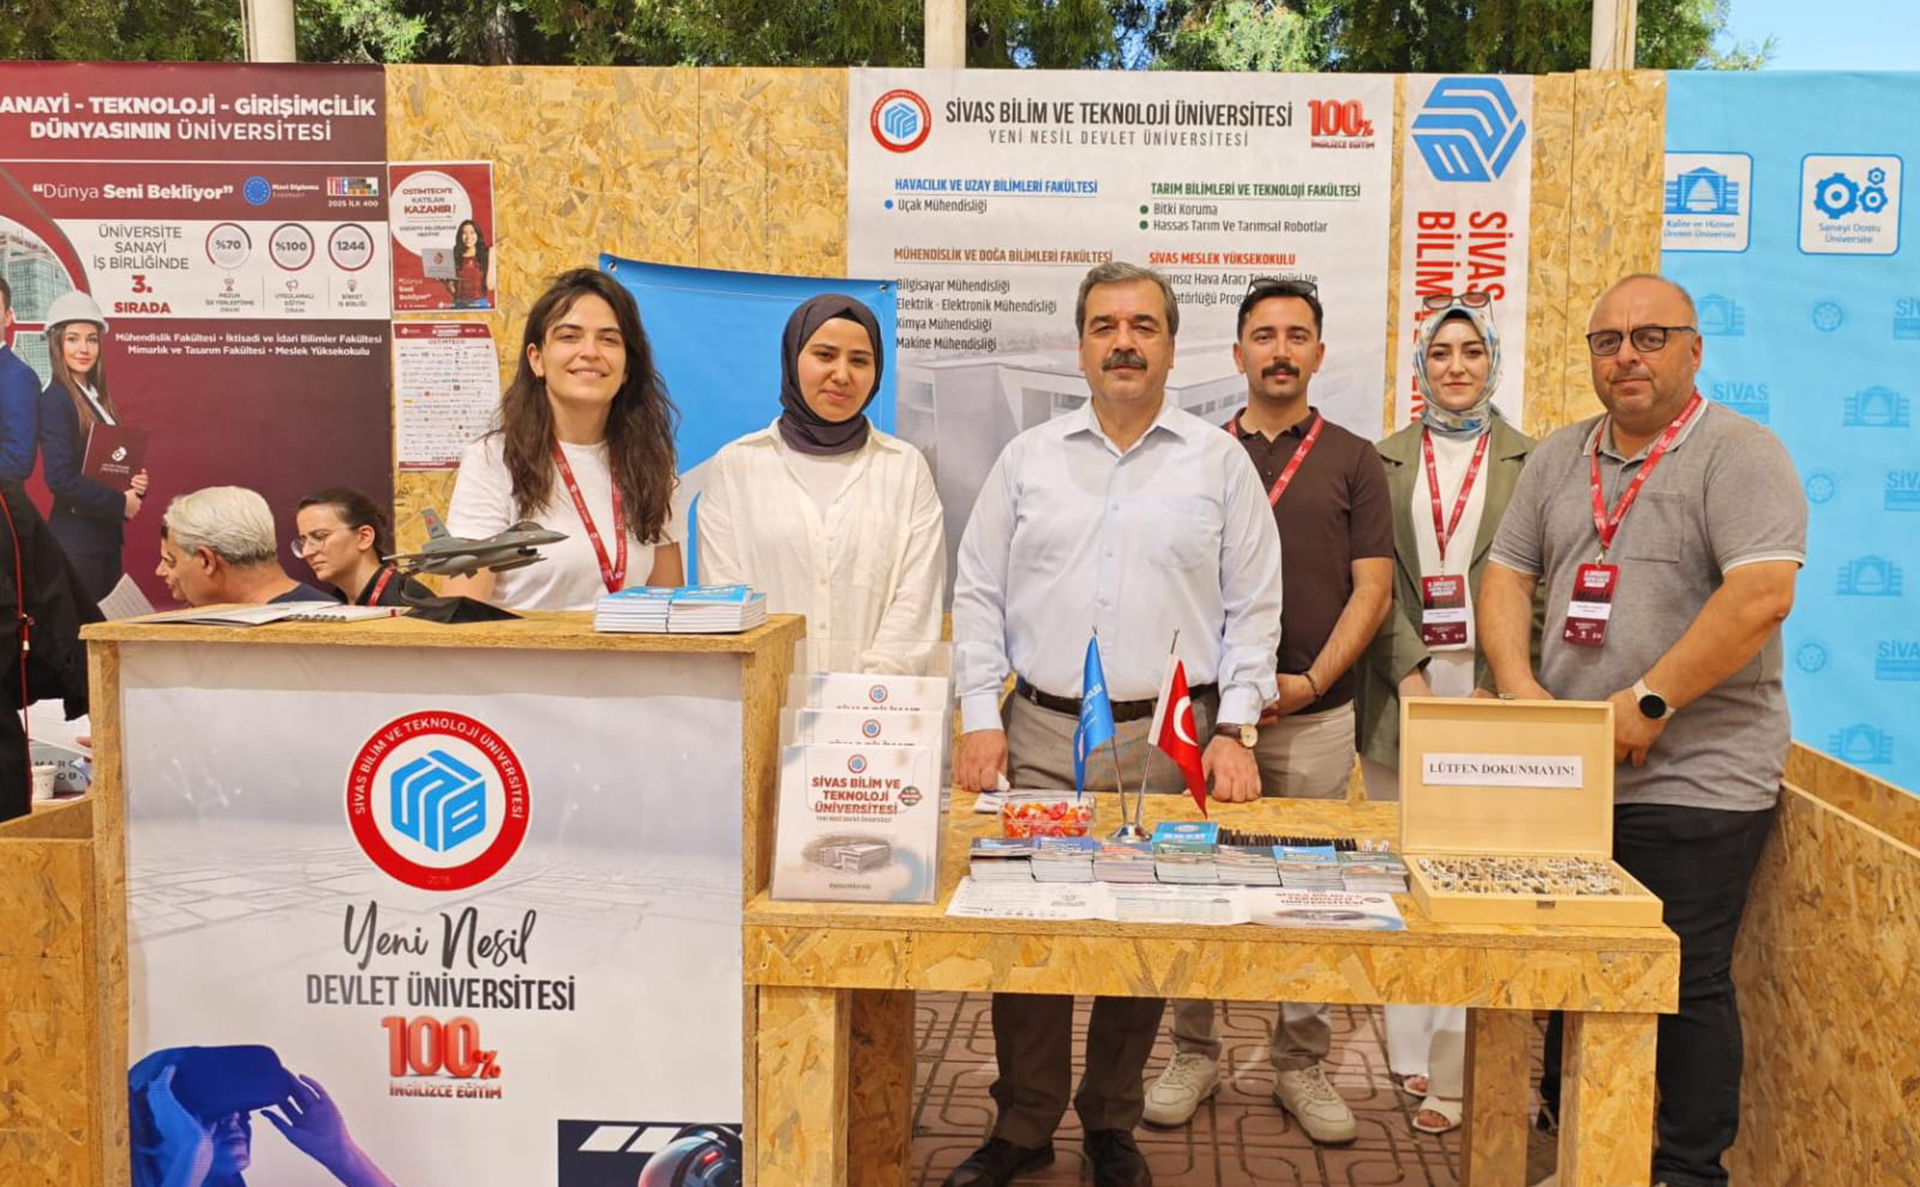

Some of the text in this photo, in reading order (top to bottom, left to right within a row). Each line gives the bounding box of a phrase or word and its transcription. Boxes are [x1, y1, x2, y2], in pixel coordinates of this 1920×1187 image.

[0, 92, 70, 114] ANAYİ
[88, 93, 216, 115] TEKNOLOJİ
[234, 94, 377, 119] GİRİŞİMCİLİK
[946, 97, 995, 123] SİVAS
[1000, 97, 1047, 124] BİLİM
[1052, 102, 1074, 124] VE
[1079, 100, 1170, 126] TEKNOLOJİ
[1175, 100, 1293, 127] ÜNİVERSİTESİ
[1307, 99, 1374, 138] 100%
[30, 118, 332, 141] DÜNYASININ ÜNİVERSİTESİ
[989, 129, 1249, 147] YENİ NESİL DEVLET ÜNİVERSİTESİ
[103, 184, 144, 199] Seni
[895, 177, 1098, 193] HAVACILIK VE UZAY BİLİMLERİ FAKÜLTESİ
[1151, 182, 1361, 198] TARIM BİLİMLERİ VE TEKNOLOJİ FAKÜLTESİ
[898, 198, 987, 214] Uçak Mühendisliği
[1153, 203, 1218, 216] Bitki Koruma
[98, 224, 182, 239] ÜNİVERSİTE
[1153, 220, 1328, 233] Hassas Tarım Ve Tarımsal Robotlar
[115, 240, 167, 254] SANAYİ
[216, 239, 241, 250] %70
[275, 241, 307, 251] %100
[336, 240, 366, 251] 1244
[93, 254, 190, 270] İŞ BİRLİĞİNDE
[894, 246, 1113, 263] MÜHENDİSLİK VE DOĞA BİLİMLERİ FAKÜLTESİ
[1149, 251, 1296, 266] SİVAS MESLEK YÜKSEKOKULU
[1415, 211, 1462, 298] BİLİM
[1467, 210, 1514, 302] SİVAS
[131, 274, 153, 294] 3.
[897, 278, 1010, 294] Bilgisayar Mühendisliği
[1195, 273, 1219, 285] Hava
[1222, 273, 1246, 285] Aracı
[114, 301, 172, 314] SIRADA
[896, 298, 933, 310] Elektrik
[942, 298, 992, 311] Elektronik
[994, 299, 1057, 315] Mühendisliği
[896, 316, 992, 332] Kimya Mühendisliği
[115, 332, 382, 344] Mühendislik Fakültesi İktisadi ve İdari Bilimler Fakültesi
[896, 336, 997, 351] Makine Mühendisliği
[128, 344, 170, 355] Mimarlık
[184, 345, 222, 355] Tasarım
[223, 345, 266, 355] Fakültesi
[275, 346, 308, 355] Meslek
[310, 346, 370, 356] Yüksekokulu
[1713, 381, 1768, 400] SİVAS
[1886, 469, 1920, 488] SİV
[354, 717, 524, 820] SİVAS BİLİM VE TEKNOLOJİ ÜNİVERSİTESİ
[1430, 760, 1575, 776] LÜTFEN DOKUNMAYIN!
[812, 775, 901, 789] SİVAS BİLİM VE
[822, 790, 889, 802] TEKNOLOJİ
[814, 801, 898, 815] ÜNİVERSİTESİ
[343, 900, 537, 971] Yeni Nesil
[306, 971, 576, 1011] DEVLET ÜNİVERSİTESİ
[381, 1015, 502, 1080] 100%
